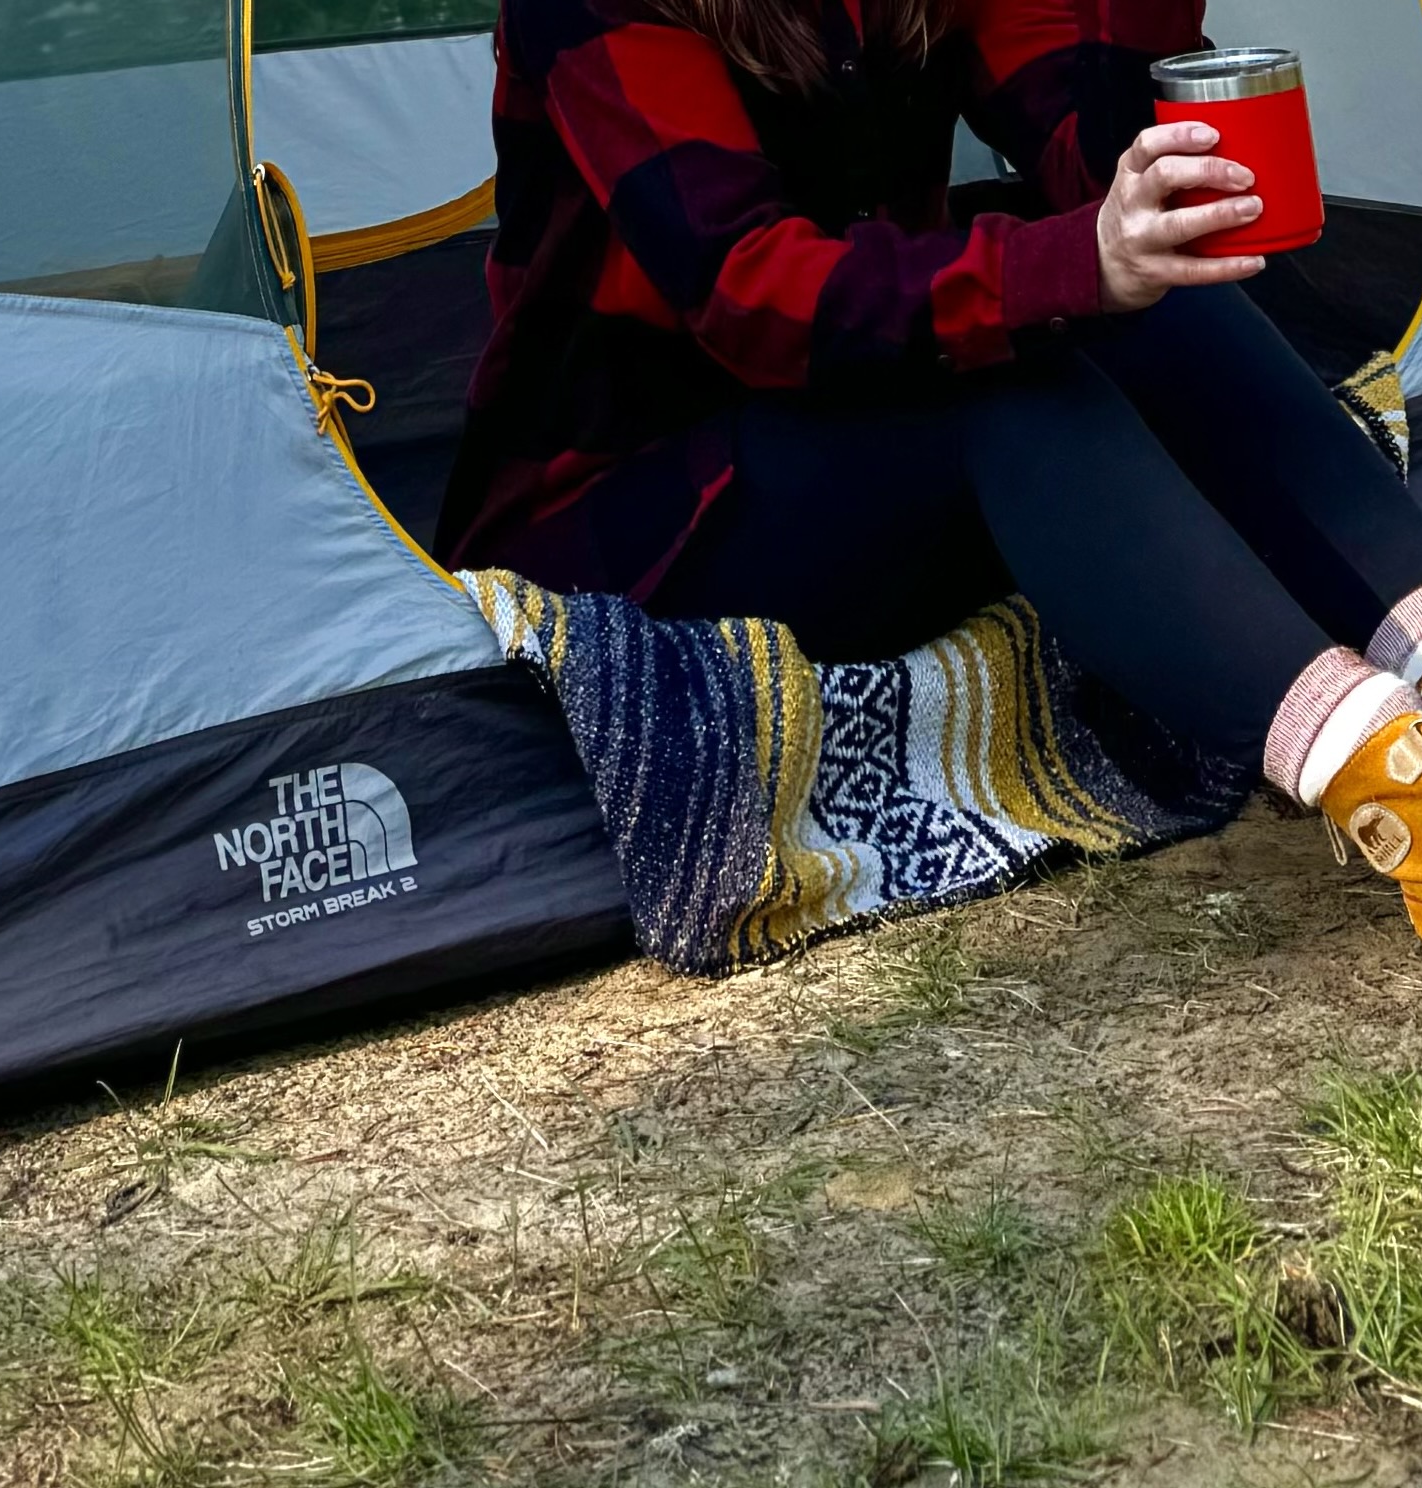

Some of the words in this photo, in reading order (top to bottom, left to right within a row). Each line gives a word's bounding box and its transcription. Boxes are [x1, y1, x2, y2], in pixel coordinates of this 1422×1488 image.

[269, 765, 342, 815] THE
[213, 804, 345, 870] NORTH
[260, 844, 350, 902] FACE
[247, 902, 320, 936] STORM
[323, 881, 397, 914] BREAK
[400, 876, 418, 892] 2
